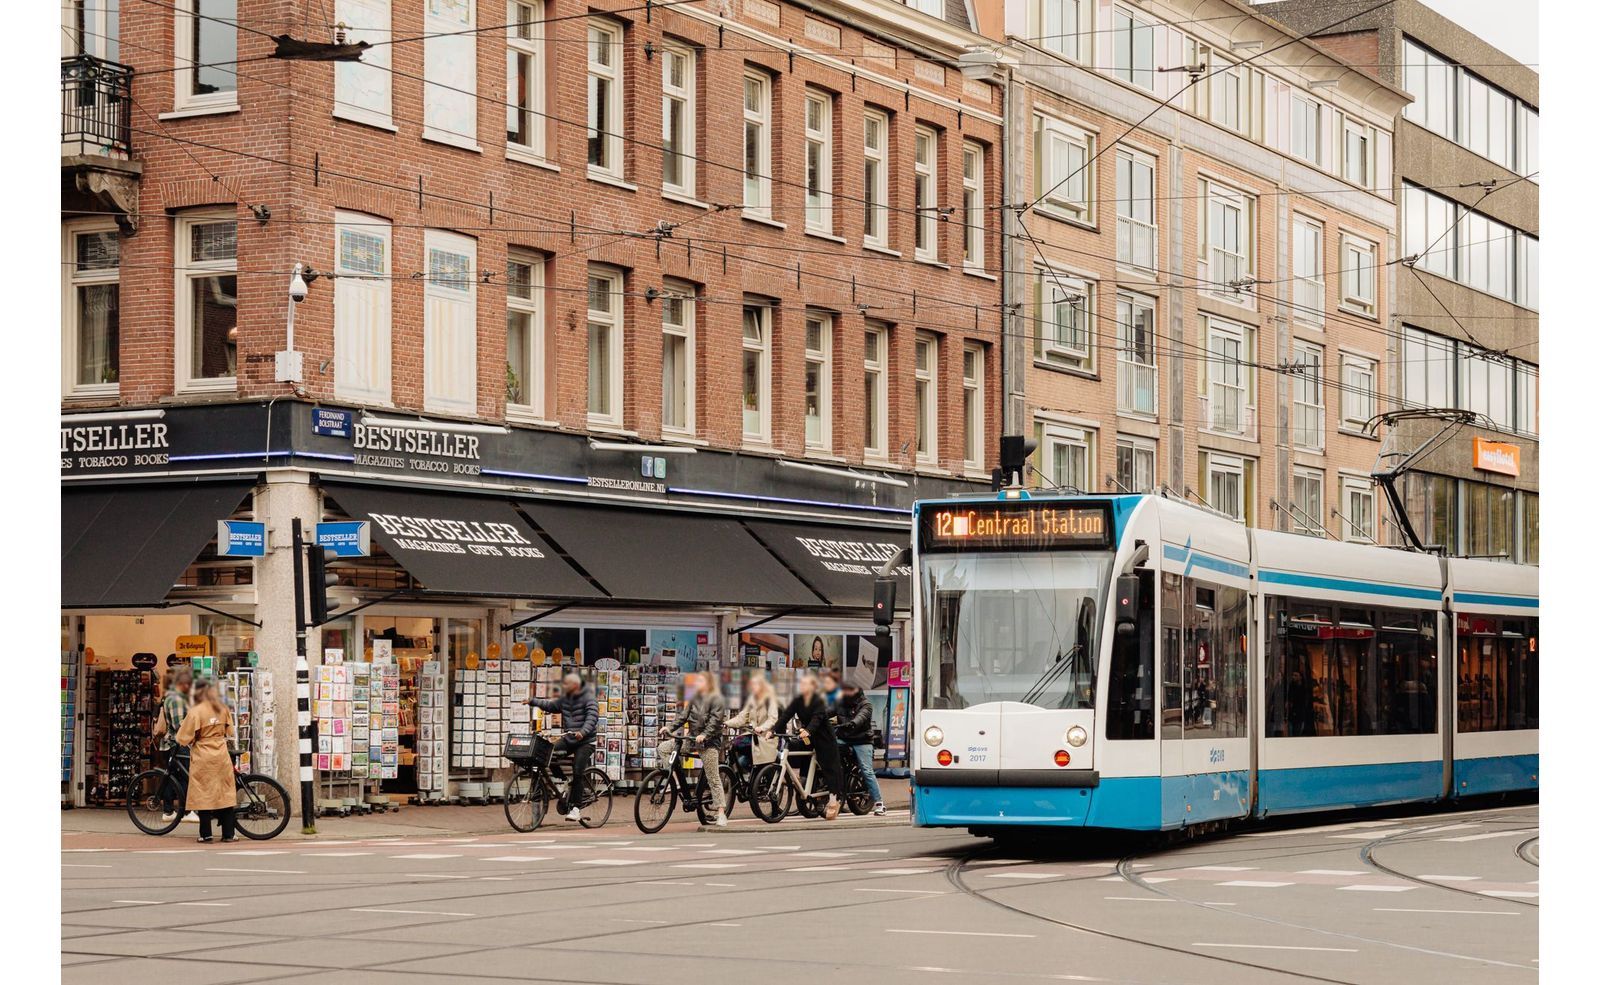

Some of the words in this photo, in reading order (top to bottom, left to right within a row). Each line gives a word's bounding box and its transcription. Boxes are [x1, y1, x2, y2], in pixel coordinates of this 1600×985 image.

[319, 410, 345, 420] FERDINAND
[319, 419, 343, 429] BOLSTRAAT
[353, 423, 480, 460] BESTSELLER
[79, 455, 128, 468] TOBACCO
[134, 453, 169, 466] BOOKS
[354, 453, 405, 469] MAGAZINES
[409, 458, 449, 473] TOBACCO
[453, 463, 481, 476] BOOKS
[587, 476, 666, 494] BESTSELLERONLINE.NL
[367, 512, 532, 545] BESTSELLER
[936, 511, 952, 536] 12
[968, 509, 1035, 536] Centraal
[1042, 508, 1102, 536] Station
[229, 532, 262, 542] BESTSELLER
[319, 533, 358, 542] BESTSELLER
[393, 537, 466, 554] MAGAZINES
[467, 544, 503, 557] GIFTS
[502, 547, 545, 559] BOOKS
[969, 754, 986, 762] 2017
